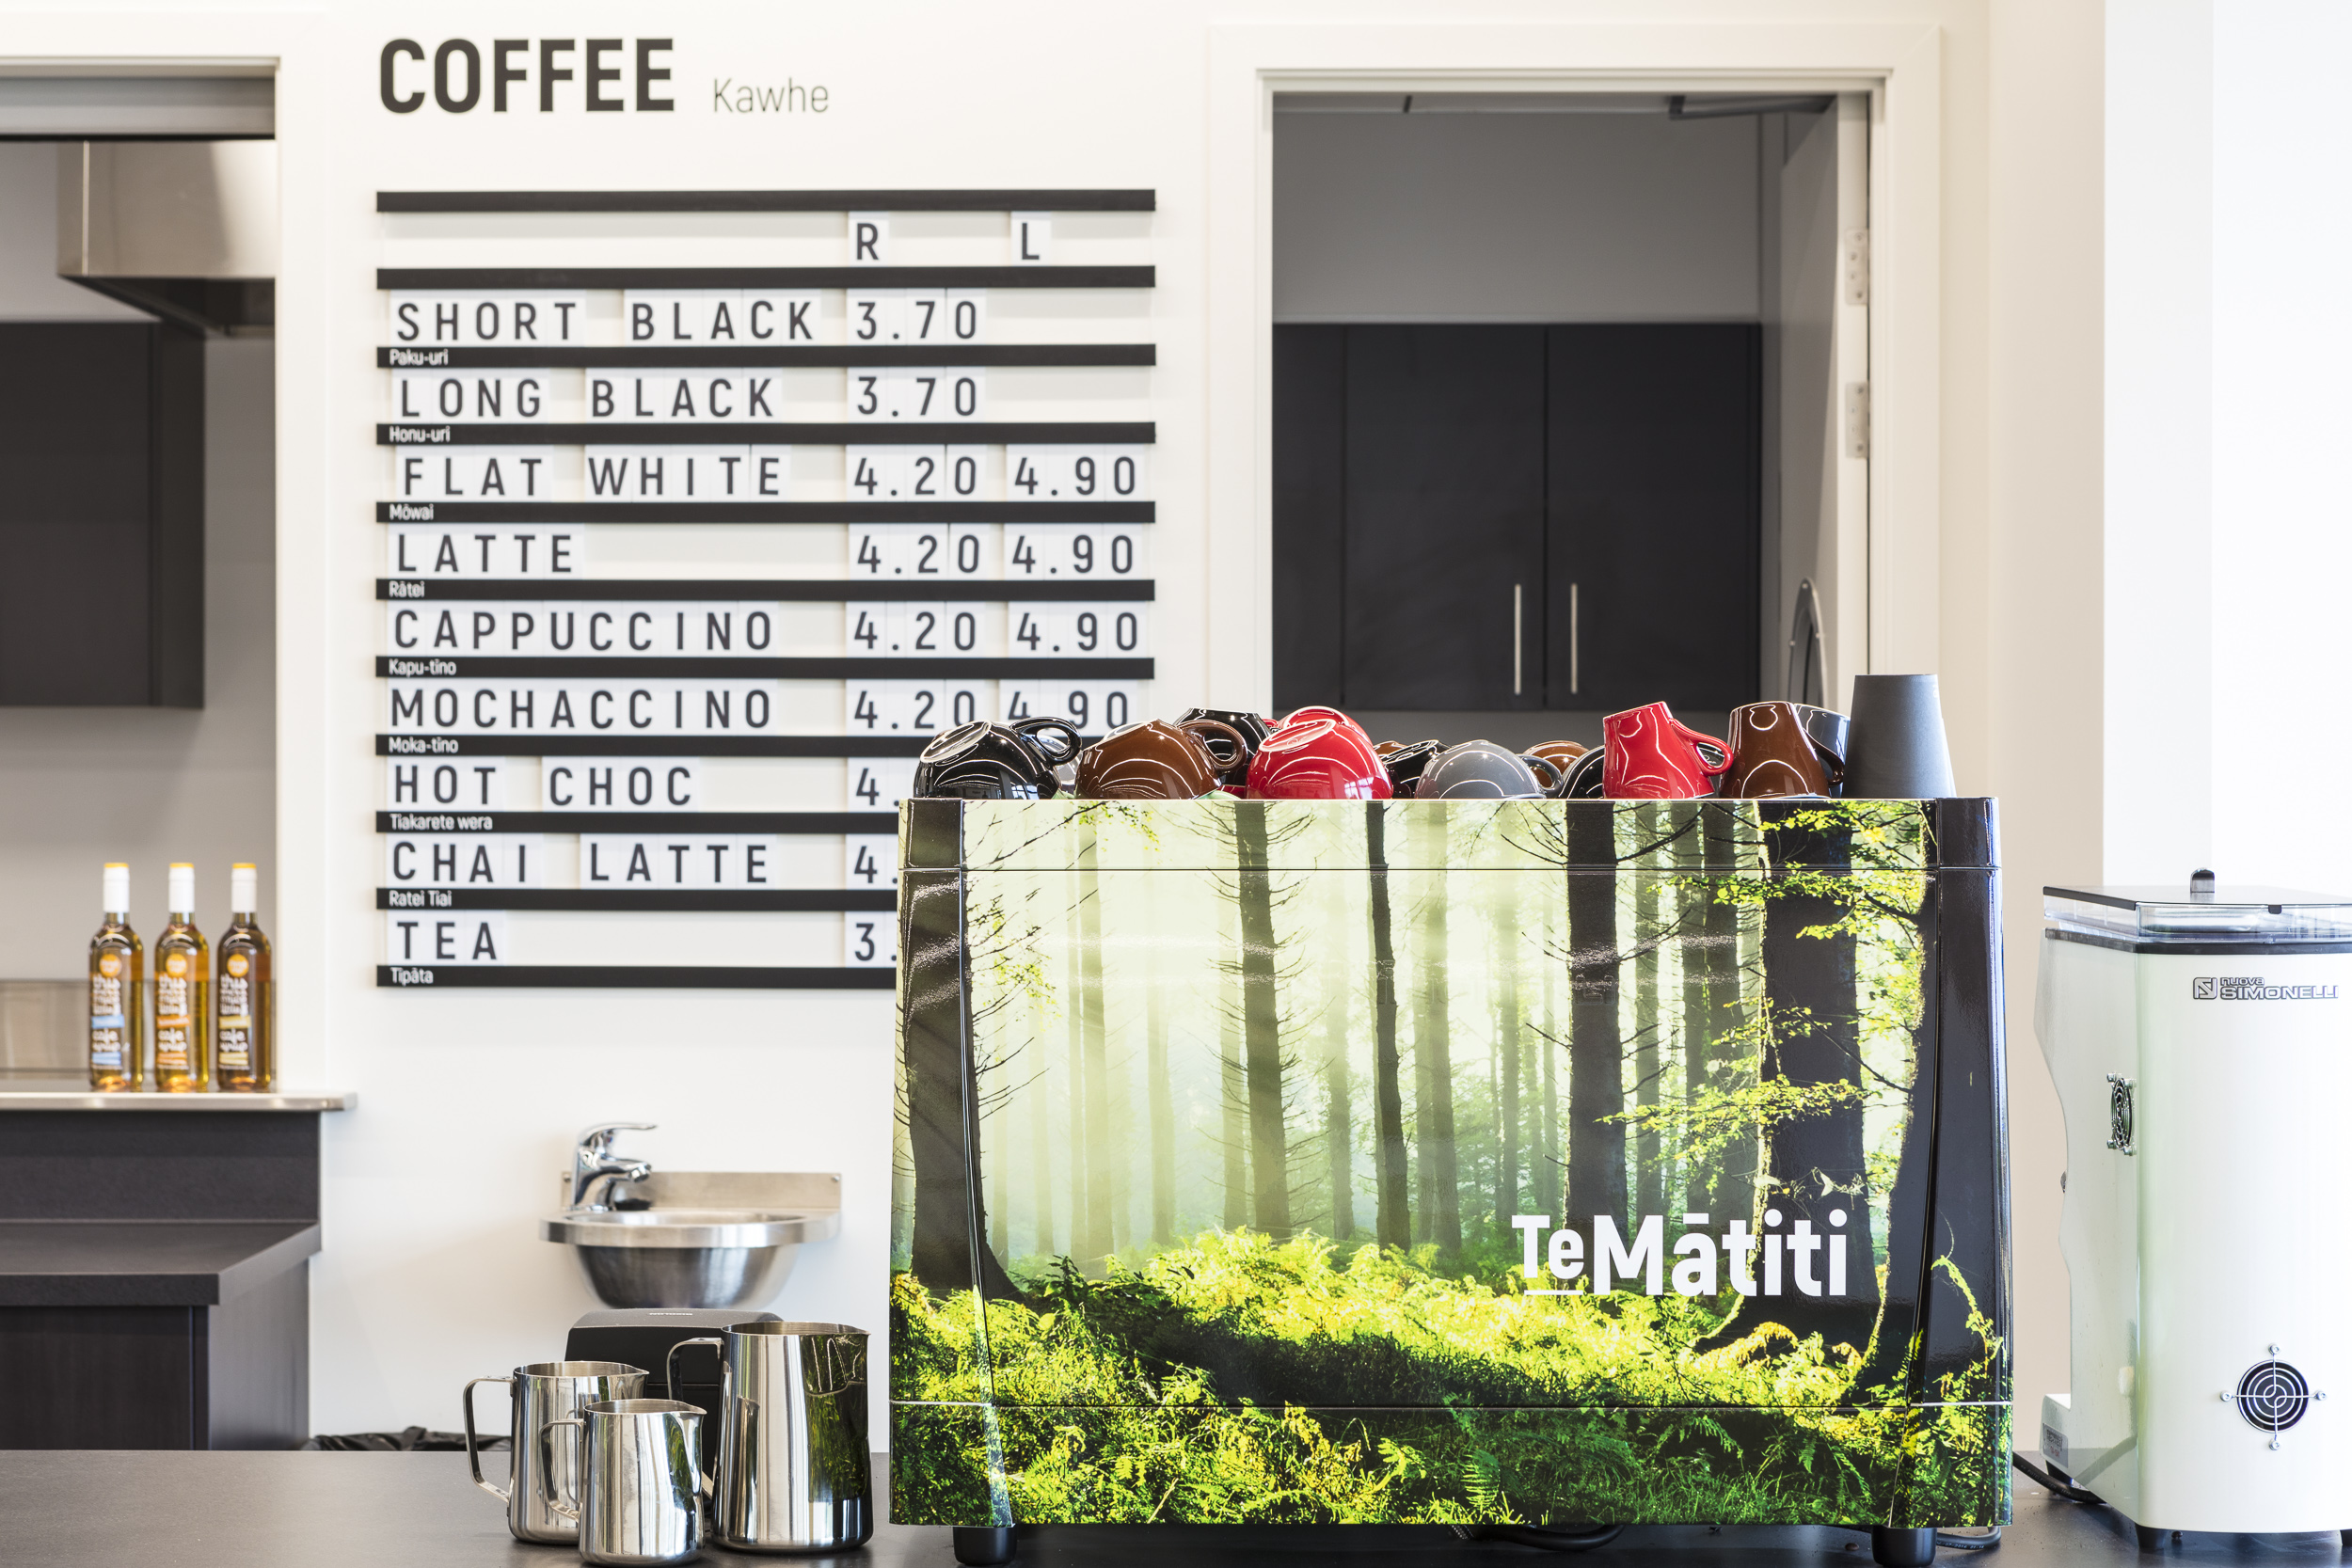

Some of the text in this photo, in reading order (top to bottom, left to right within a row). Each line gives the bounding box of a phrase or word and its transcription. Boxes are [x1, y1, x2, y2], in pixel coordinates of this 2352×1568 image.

[380, 38, 829, 114] COFFEE Kawhe
[856, 222, 1040, 261] R L
[397, 300, 977, 341] SHORT BLACK 3.70
[389, 348, 449, 366] Paku-uri
[402, 376, 976, 418] LONG BLACK 3.70
[389, 425, 451, 443] Honu-uri
[405, 456, 1136, 497] FLAT WHITE 4.20 4.90
[398, 533, 1133, 575] LATTE 4.20 4.90
[395, 610, 1137, 653] CAPPUCCINO 4.20 4.90
[391, 689, 1128, 730] MOCHACCINO 4.20 490
[395, 765, 496, 805] HOT
[549, 767, 691, 806] CHOC
[389, 813, 493, 831] Tiakarete wera
[393, 841, 526, 883] CHAI
[591, 843, 767, 883] LATTE
[389, 889, 453, 908] Ratei Tiai
[396, 921, 497, 960] TEA
[2220, 977, 2265, 986] nuova
[2221, 986, 2338, 1000] SIMONELLI
